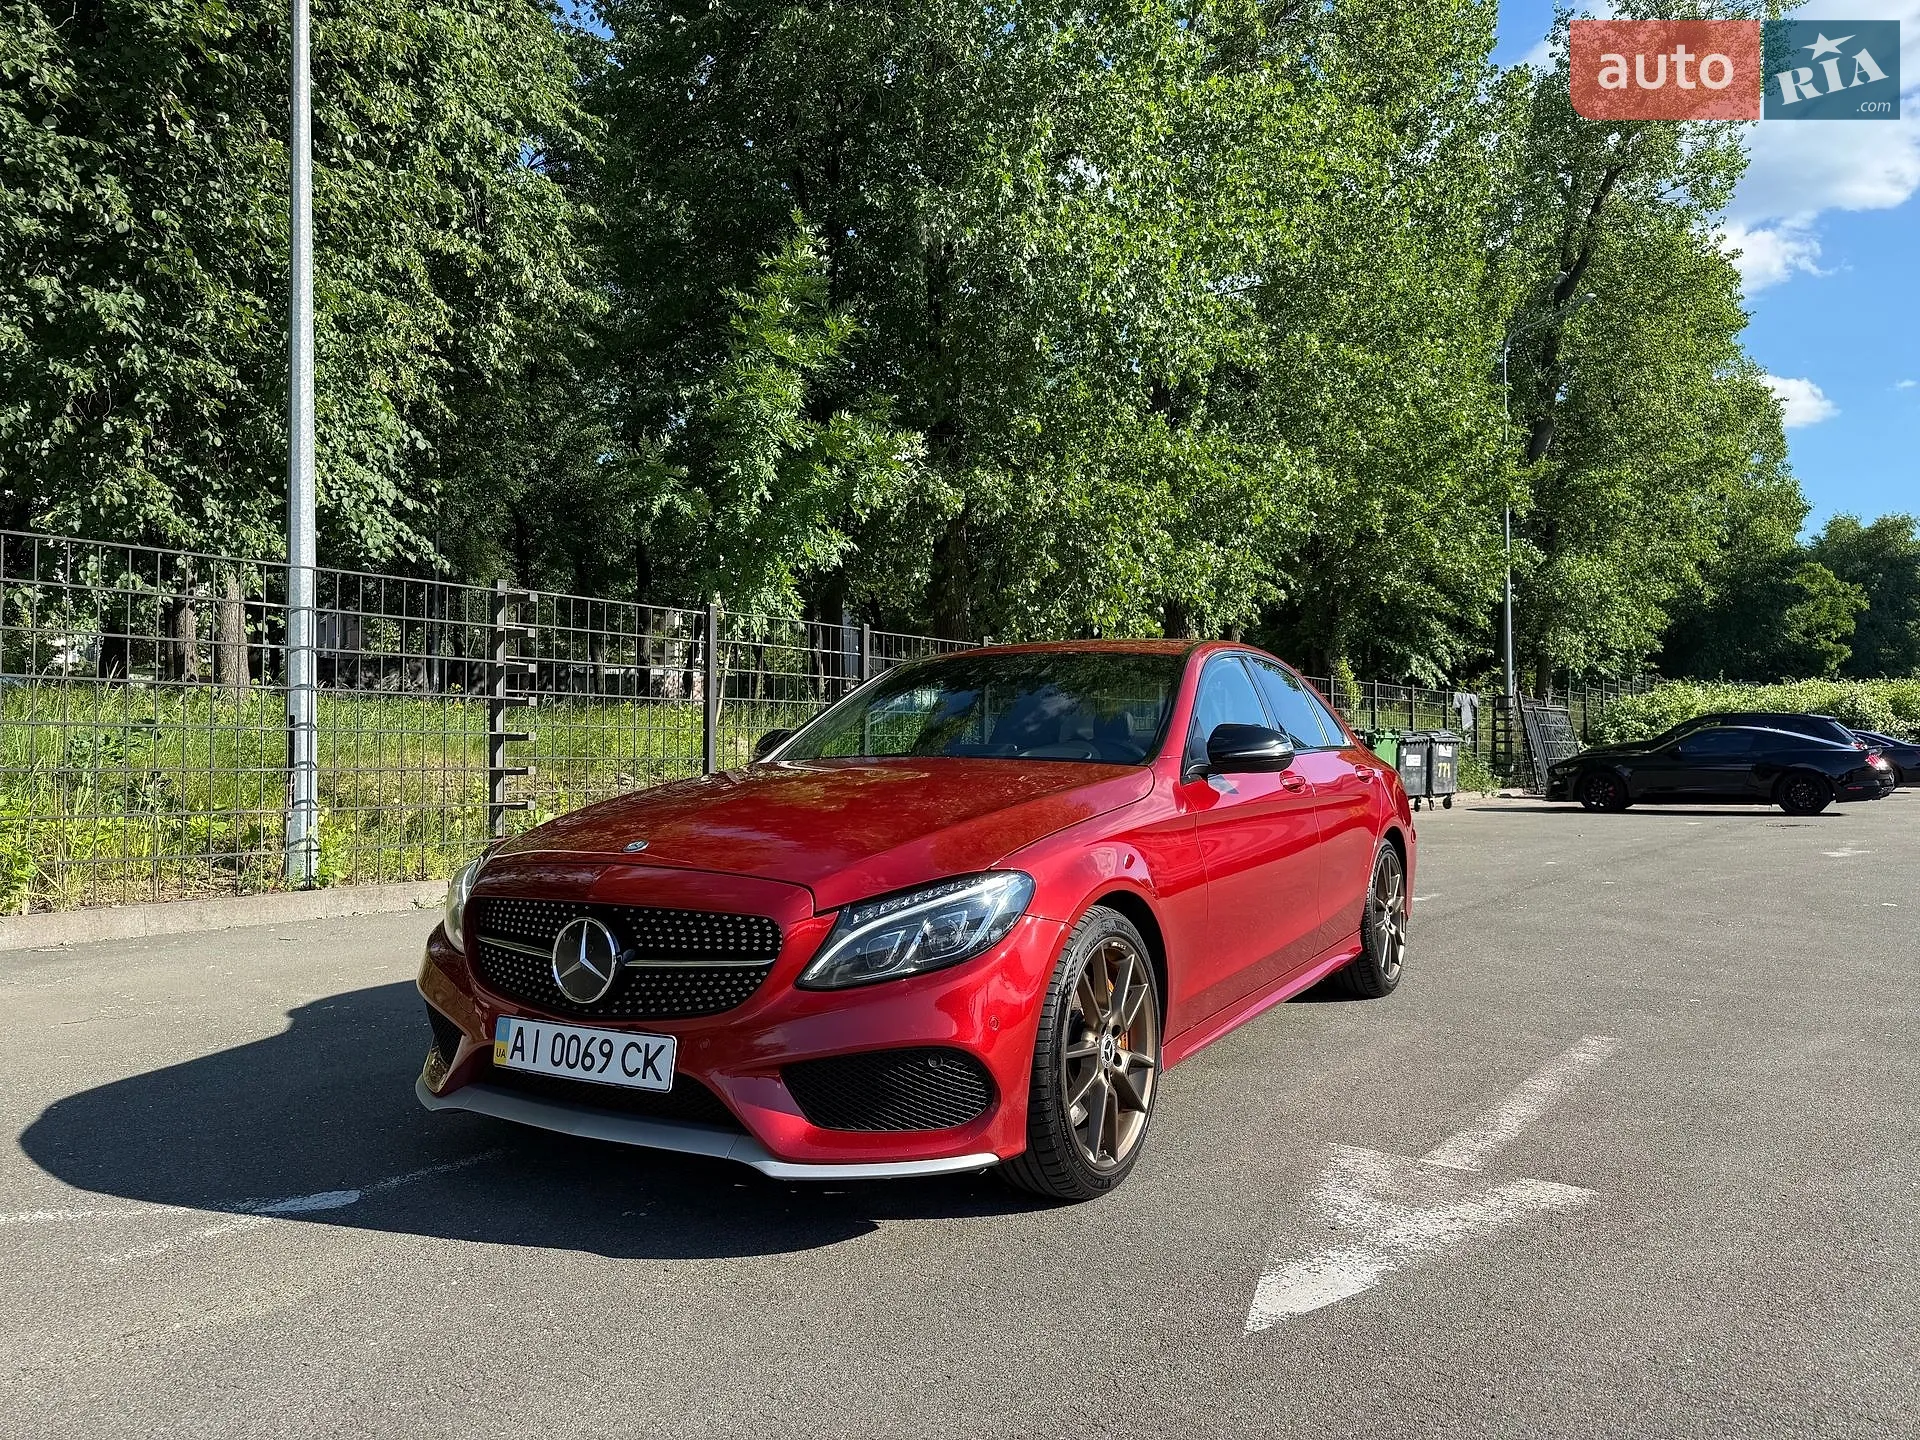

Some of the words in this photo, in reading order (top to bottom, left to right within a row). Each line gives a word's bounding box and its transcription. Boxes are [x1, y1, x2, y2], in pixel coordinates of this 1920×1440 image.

[496, 1048, 506, 1058] UA
[509, 1026, 540, 1064] AI
[550, 1032, 614, 1074] 0069
[621, 1041, 667, 1082] CK
